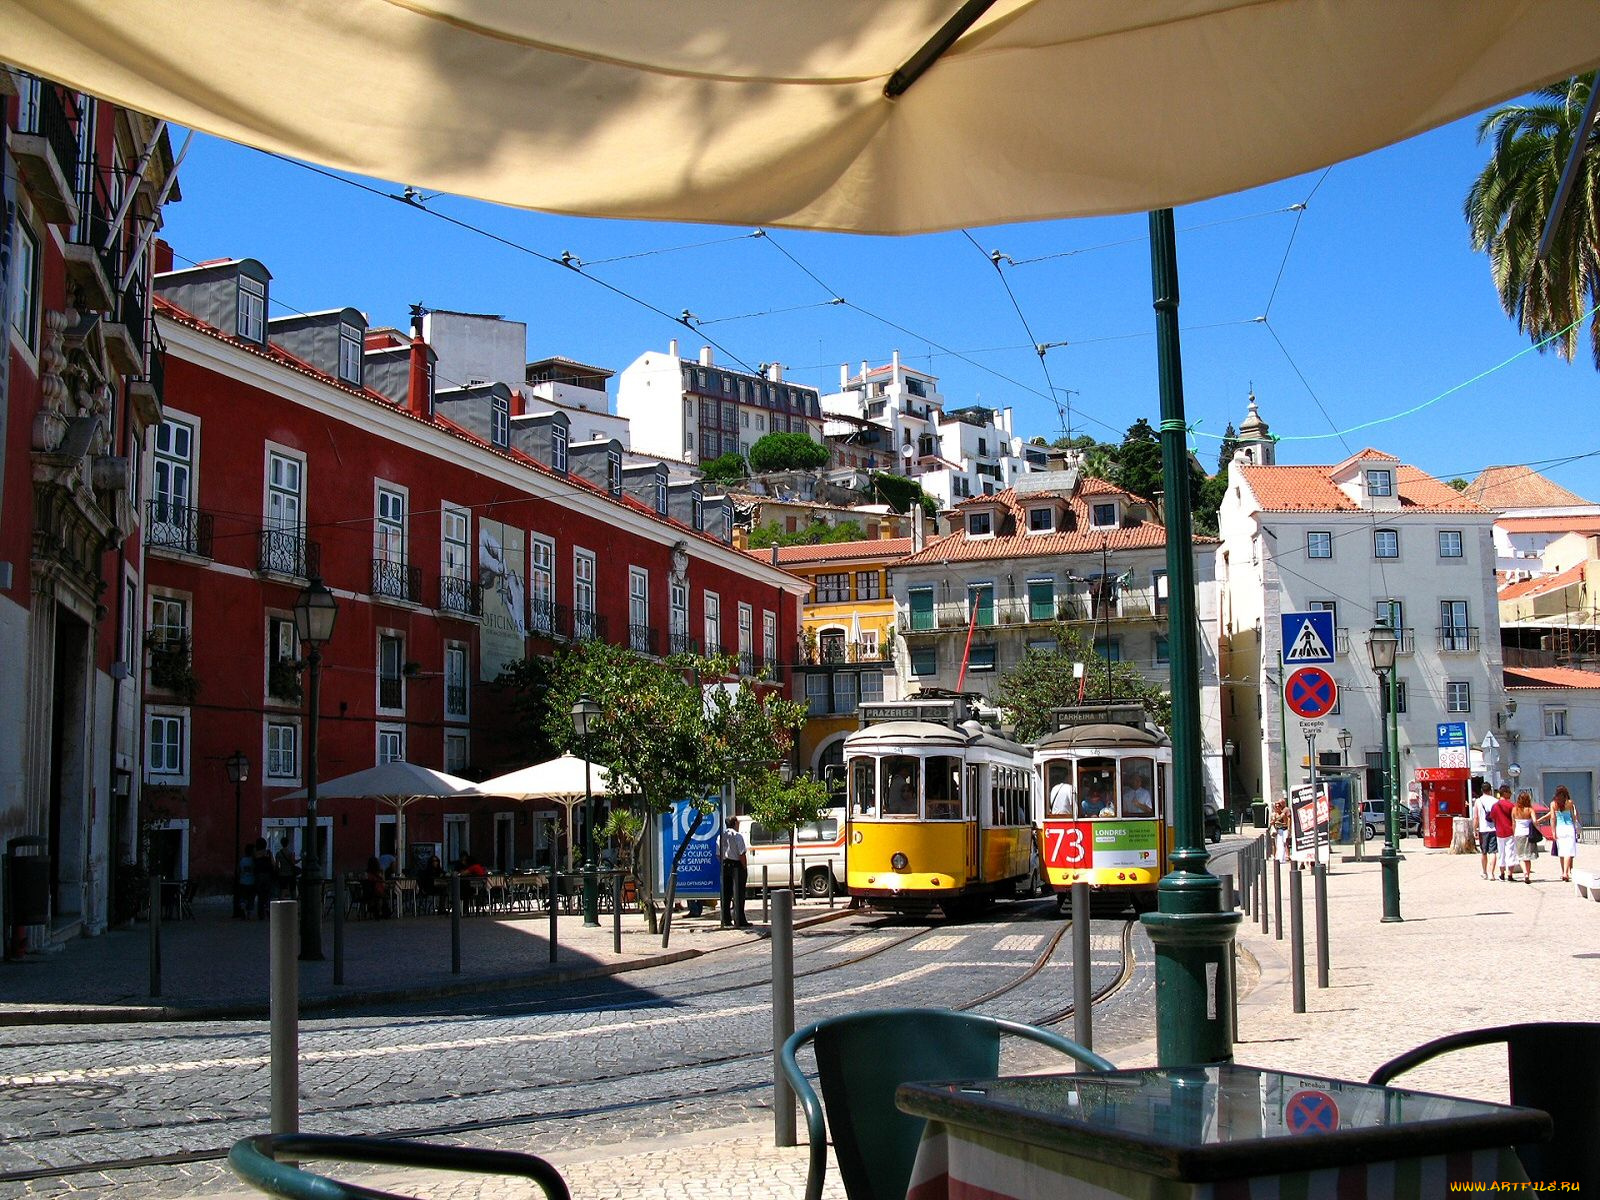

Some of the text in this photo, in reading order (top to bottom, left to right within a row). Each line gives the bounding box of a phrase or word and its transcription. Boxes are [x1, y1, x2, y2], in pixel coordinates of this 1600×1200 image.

[482, 612, 523, 634] OFICINAS
[866, 708, 914, 717] PRAZERES
[1059, 713, 1095, 721] CARREIRA
[1440, 728, 1447, 736] P
[669, 801, 720, 841] 10
[687, 857, 712, 865] SEMPRE
